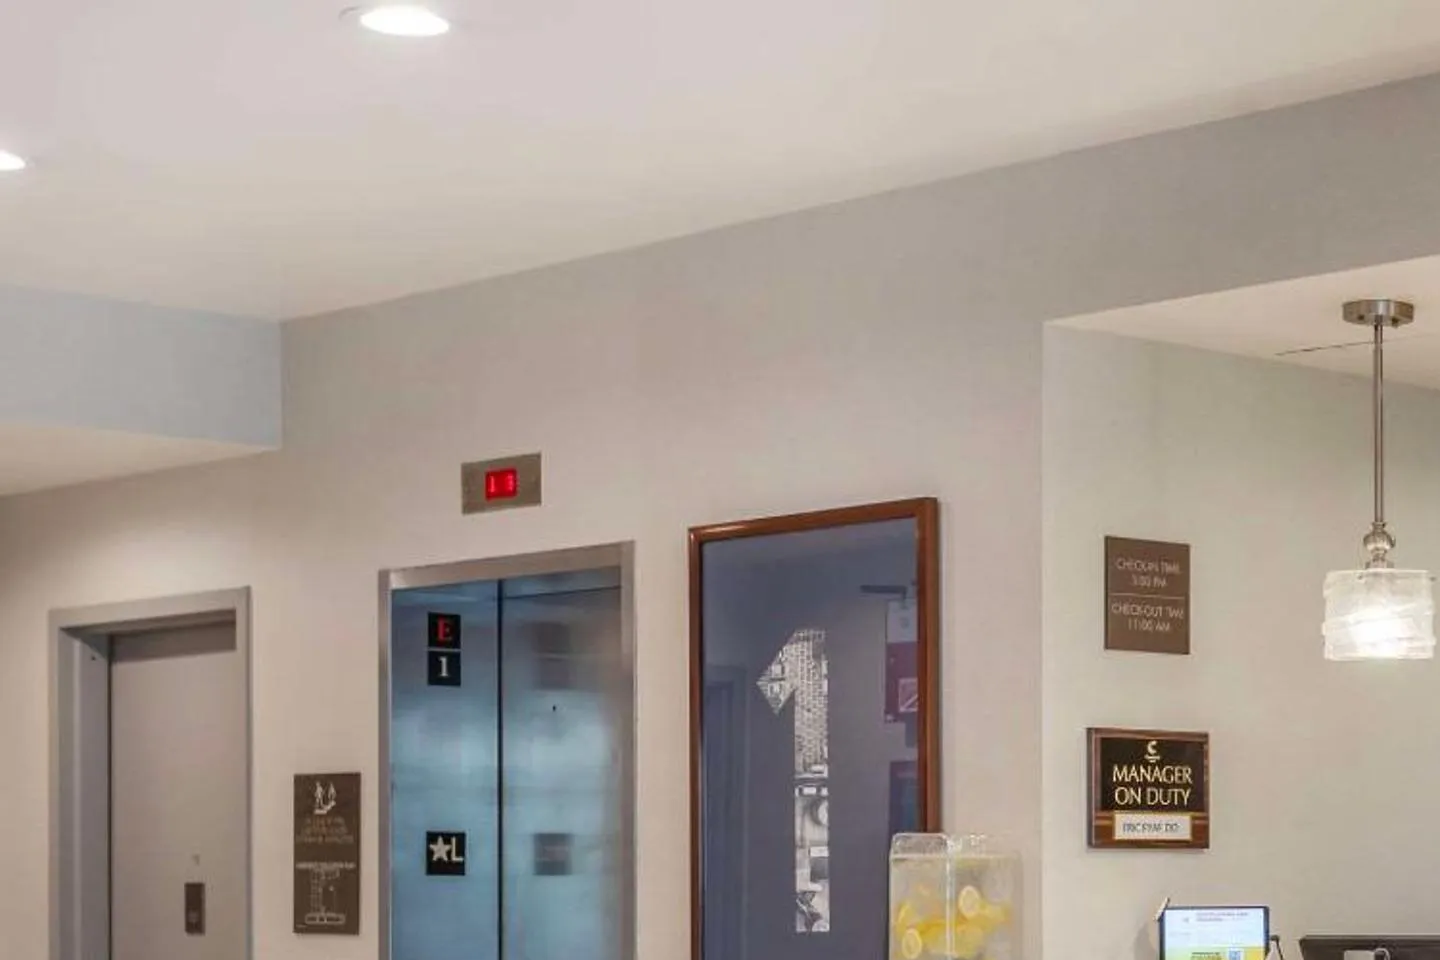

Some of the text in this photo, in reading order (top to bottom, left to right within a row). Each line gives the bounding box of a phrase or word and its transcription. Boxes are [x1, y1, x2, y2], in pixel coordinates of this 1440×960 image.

[436, 616, 454, 641] E
[438, 655, 450, 677] 1
[1112, 764, 1193, 785] MANAGER
[1114, 786, 1192, 807] ON DUTY
[450, 835, 464, 862] L
